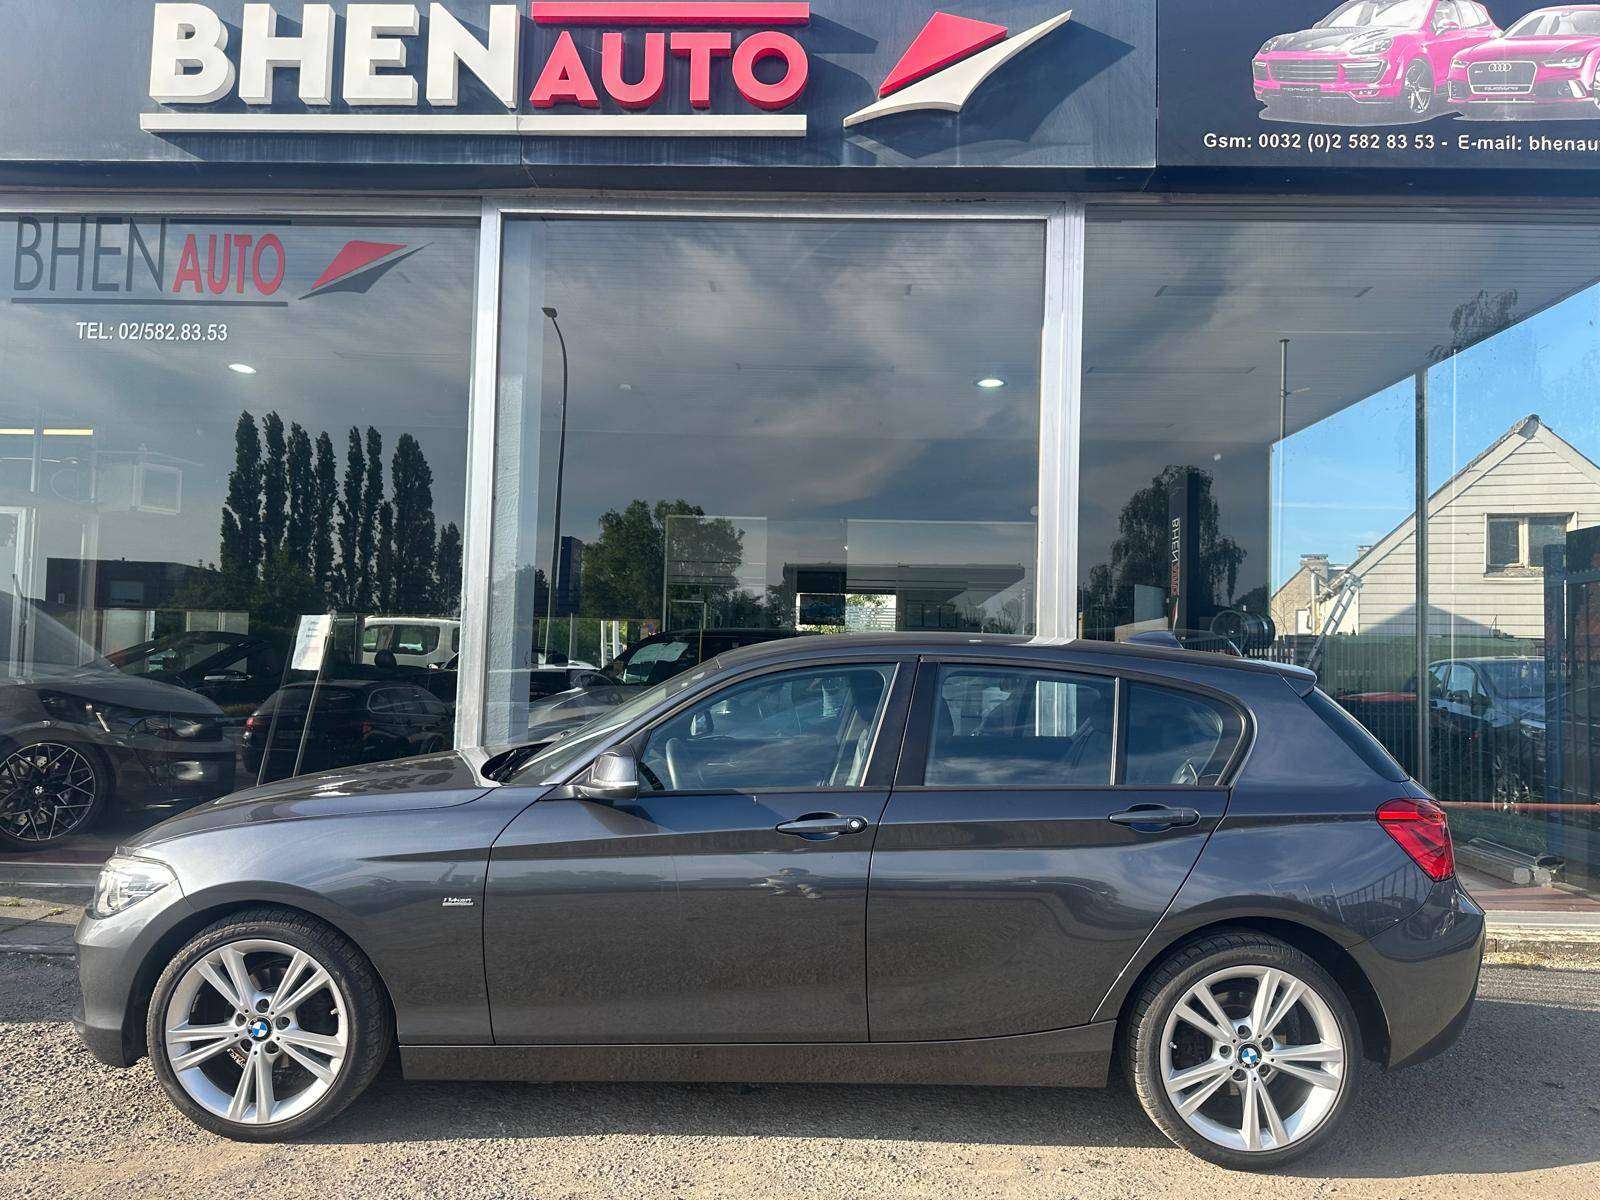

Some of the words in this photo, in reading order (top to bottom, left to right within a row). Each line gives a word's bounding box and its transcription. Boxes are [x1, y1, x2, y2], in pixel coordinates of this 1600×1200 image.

[149, 2, 519, 109] BHEN
[529, 30, 810, 110] AUTO
[1203, 133, 1251, 148] Gsm:
[1258, 133, 1301, 148] 0032
[1307, 133, 1342, 152] (0)2
[1348, 134, 1380, 149] 582
[1386, 134, 1408, 149] 83
[1414, 135, 1435, 149] 53
[1457, 134, 1522, 150] E-mail:
[1529, 135, 1600, 151] bhenau
[13, 216, 166, 292] BHEN
[172, 233, 285, 295] AUTO
[76, 322, 113, 340] TEL:
[118, 322, 228, 342] 02/582.83.53
